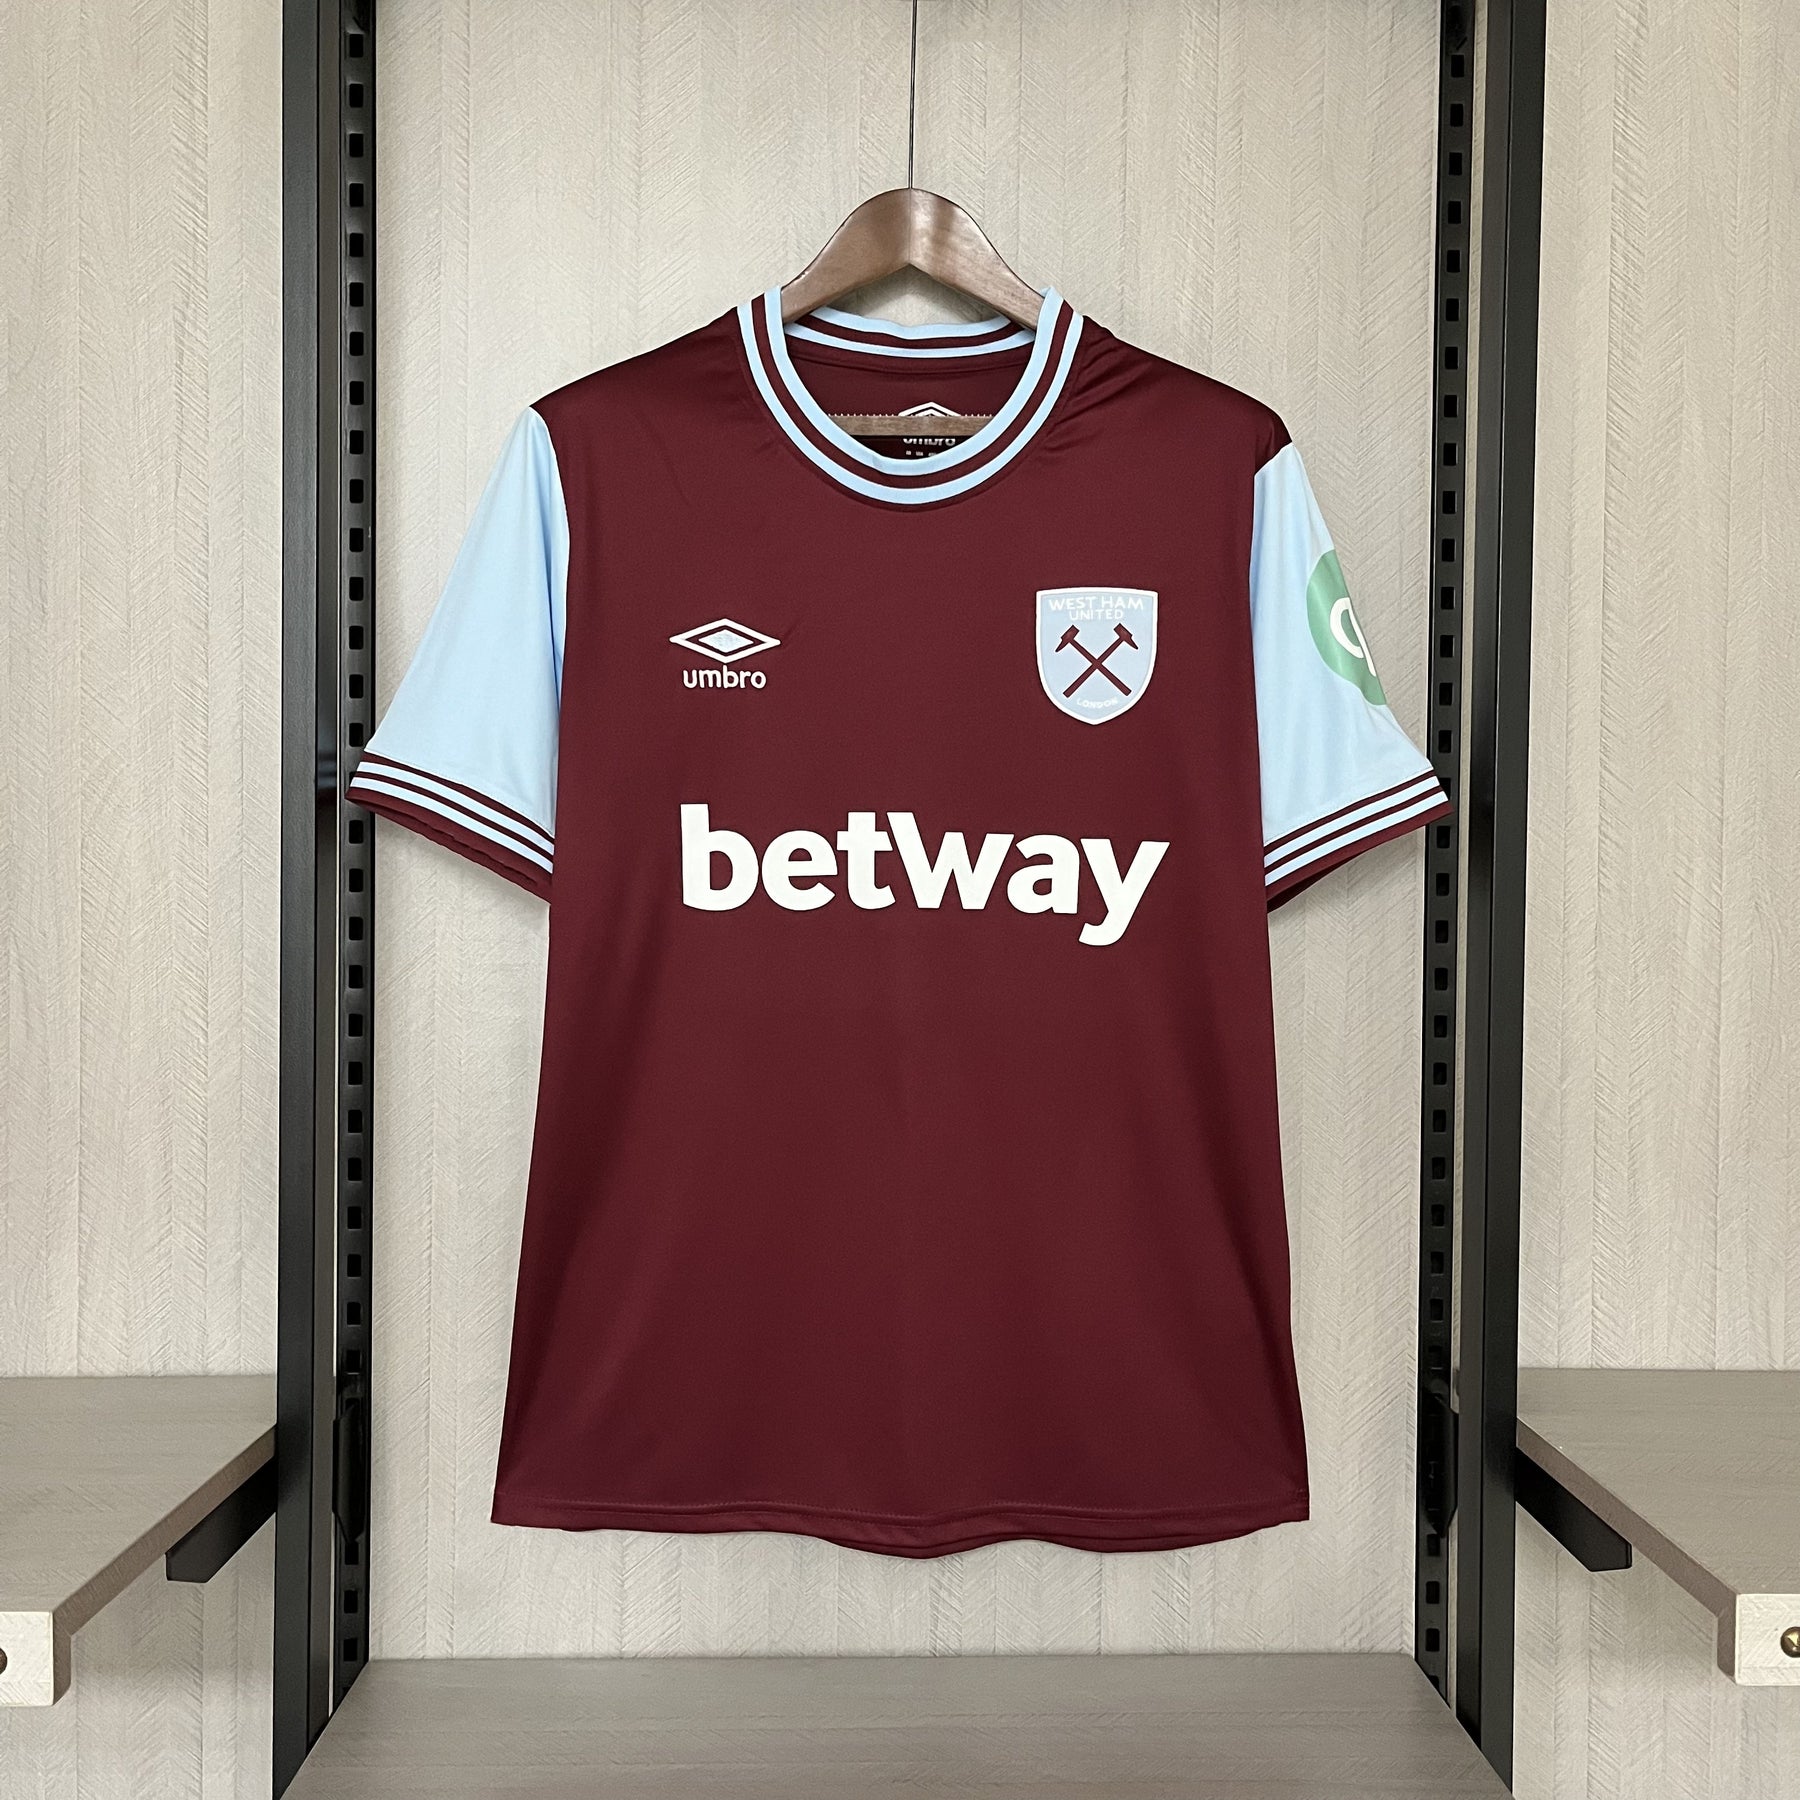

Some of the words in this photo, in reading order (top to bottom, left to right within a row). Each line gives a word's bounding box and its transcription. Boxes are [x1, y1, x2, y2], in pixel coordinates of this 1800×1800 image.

[1049, 596, 1096, 611] WEST
[1102, 596, 1144, 610] HAM
[1069, 608, 1124, 620] UNITED
[683, 665, 767, 689] umbro
[1077, 696, 1119, 709] LONDON
[680, 803, 1170, 946] betway
